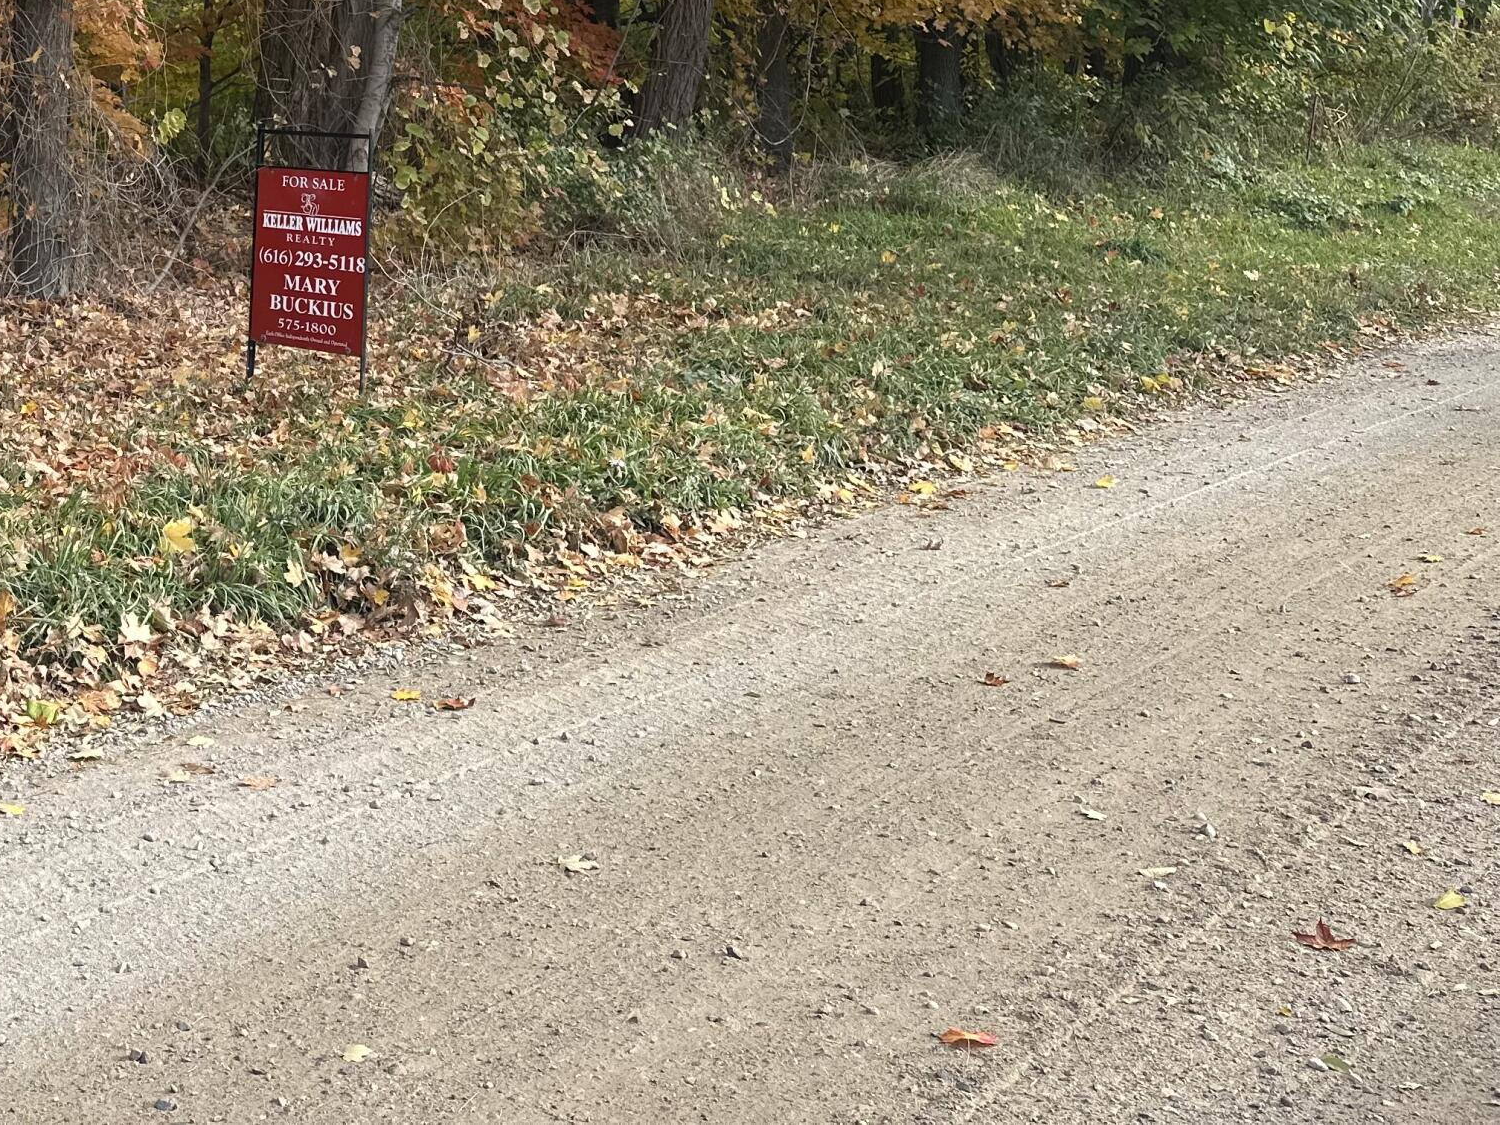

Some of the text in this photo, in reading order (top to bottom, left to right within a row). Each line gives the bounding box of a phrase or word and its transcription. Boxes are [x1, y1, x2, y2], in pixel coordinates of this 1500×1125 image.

[282, 176, 345, 191] FOR SALE
[263, 212, 362, 236] KELLER WILLIAMS
[286, 233, 335, 246] REALTY
[259, 246, 365, 273] (616) 293-5118
[284, 274, 341, 296] MARY
[270, 295, 354, 320] BUCKIUS
[278, 318, 336, 335] 575-1800
